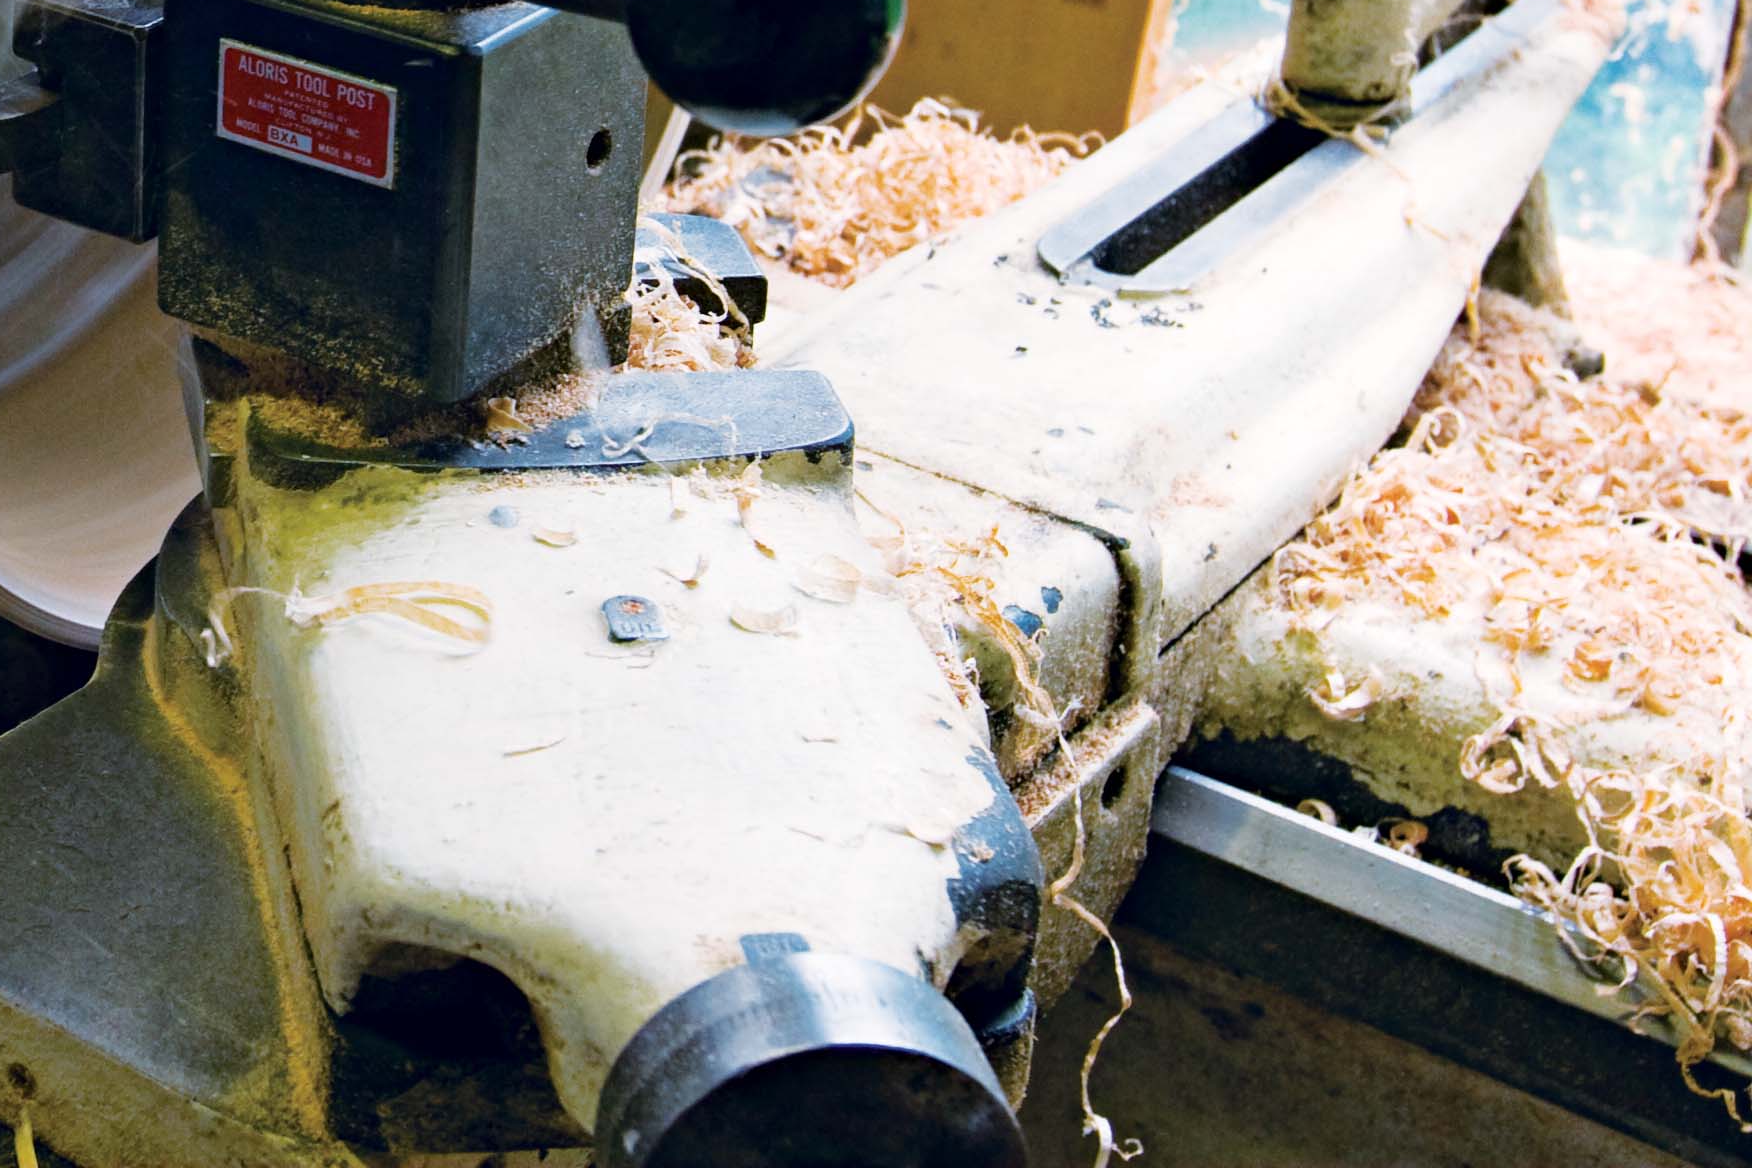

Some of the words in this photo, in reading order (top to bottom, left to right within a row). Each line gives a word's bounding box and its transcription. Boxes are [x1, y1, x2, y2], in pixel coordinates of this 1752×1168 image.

[238, 55, 288, 85] ALORIS
[295, 72, 331, 98] TOOL
[337, 84, 376, 110] POST
[248, 97, 274, 114] ALORIS
[279, 106, 297, 121] TOOL
[270, 128, 298, 147] BXA
[318, 143, 340, 159] MADE
